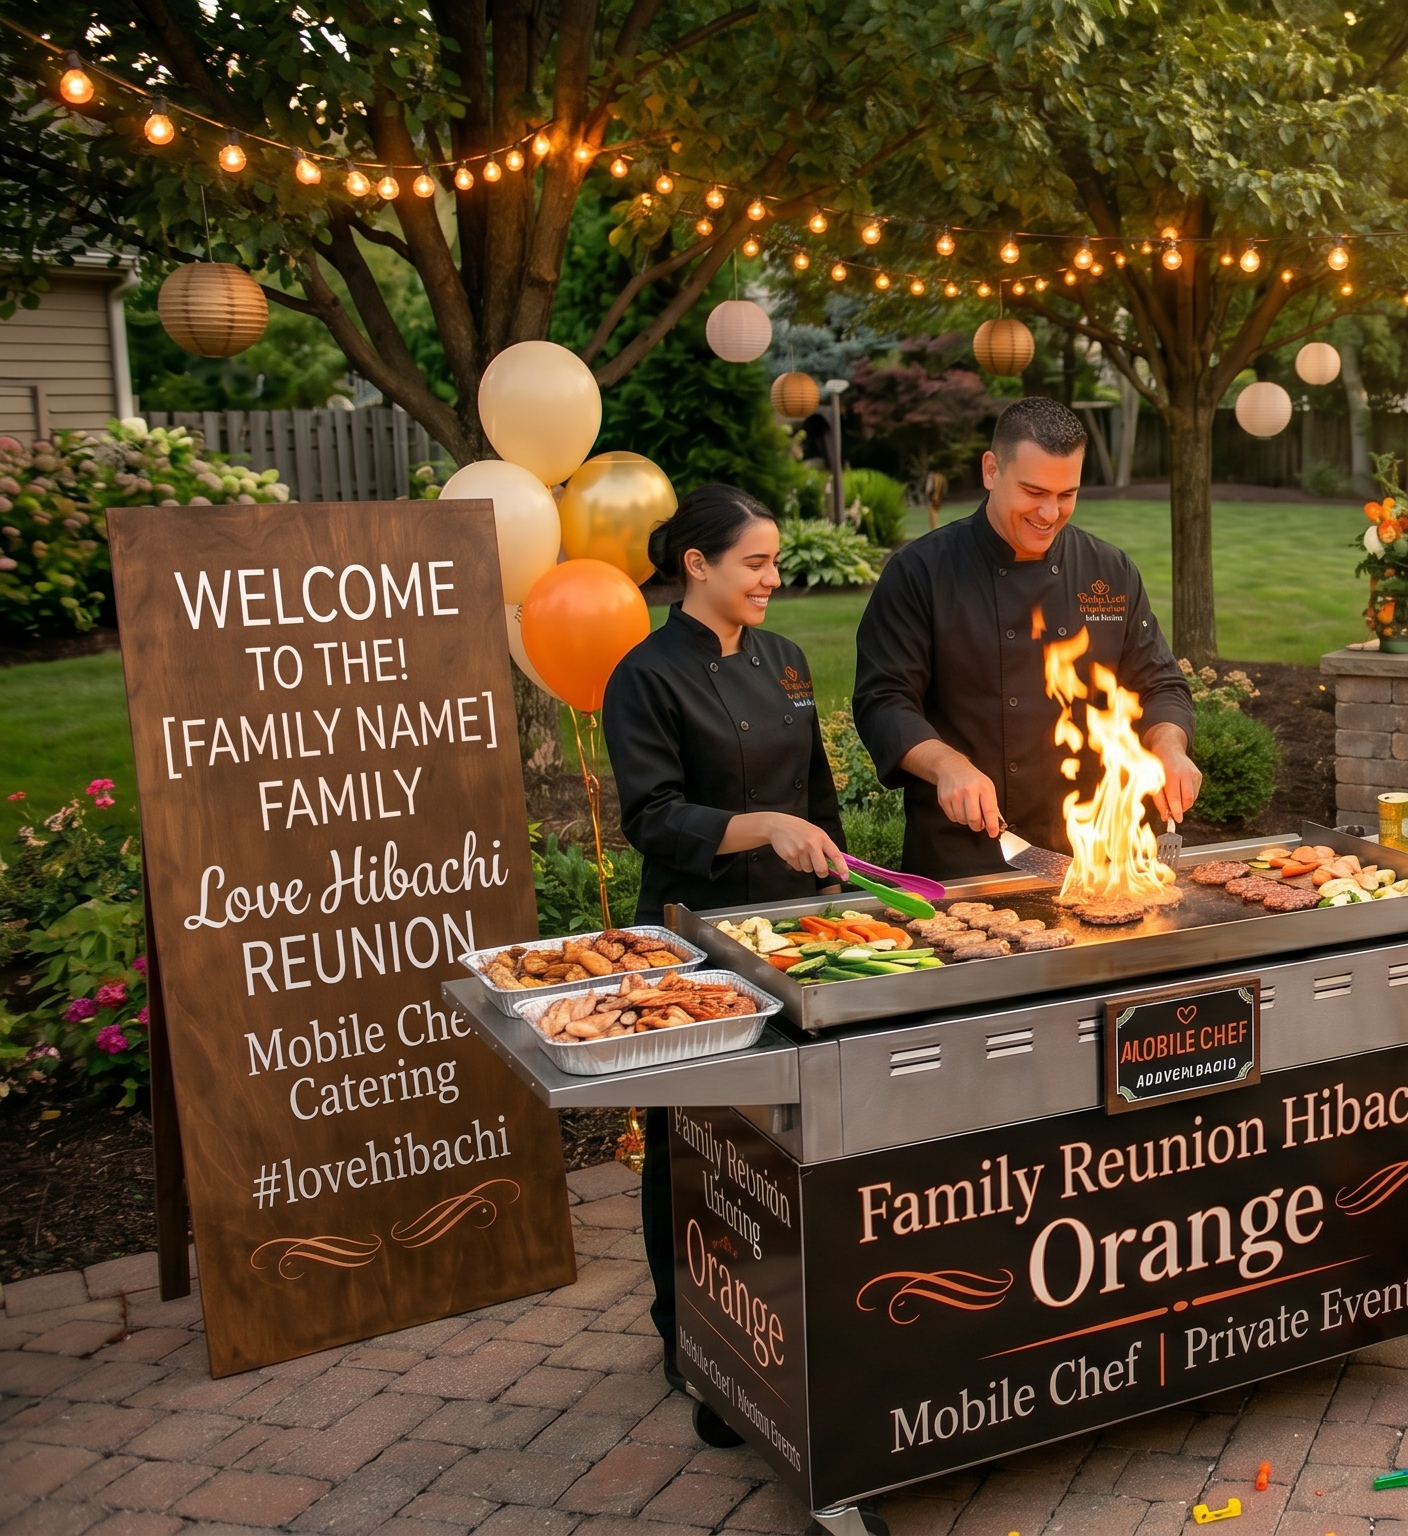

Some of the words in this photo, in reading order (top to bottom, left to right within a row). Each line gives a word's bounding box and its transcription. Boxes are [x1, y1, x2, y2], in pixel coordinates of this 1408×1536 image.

[174, 560, 460, 630] WELCOME
[245, 644, 304, 691] TO
[313, 637, 409, 686] THE!
[162, 707, 342, 780] [FAMILY
[356, 691, 498, 752] NAME]
[258, 766, 422, 831] FAMILY
[183, 865, 311, 931] Love
[319, 830, 509, 915] Hibachi
[242, 910, 476, 997] REUNION
[244, 1014, 387, 1076] Mobile
[397, 1000, 479, 1048] Che
[1200, 1020, 1248, 1050] CHEF
[289, 1058, 460, 1121] Catering
[252, 1115, 512, 1210] #lovehibachi
[858, 1154, 1044, 1245] Family
[1059, 1116, 1267, 1199] Reunion
[1028, 1183, 1324, 1308] Orange
[687, 1218, 785, 1367] Orange
[890, 1379, 1036, 1454] Mobile
[1050, 1341, 1142, 1408] Chef
[1183, 1303, 1309, 1371] Private
